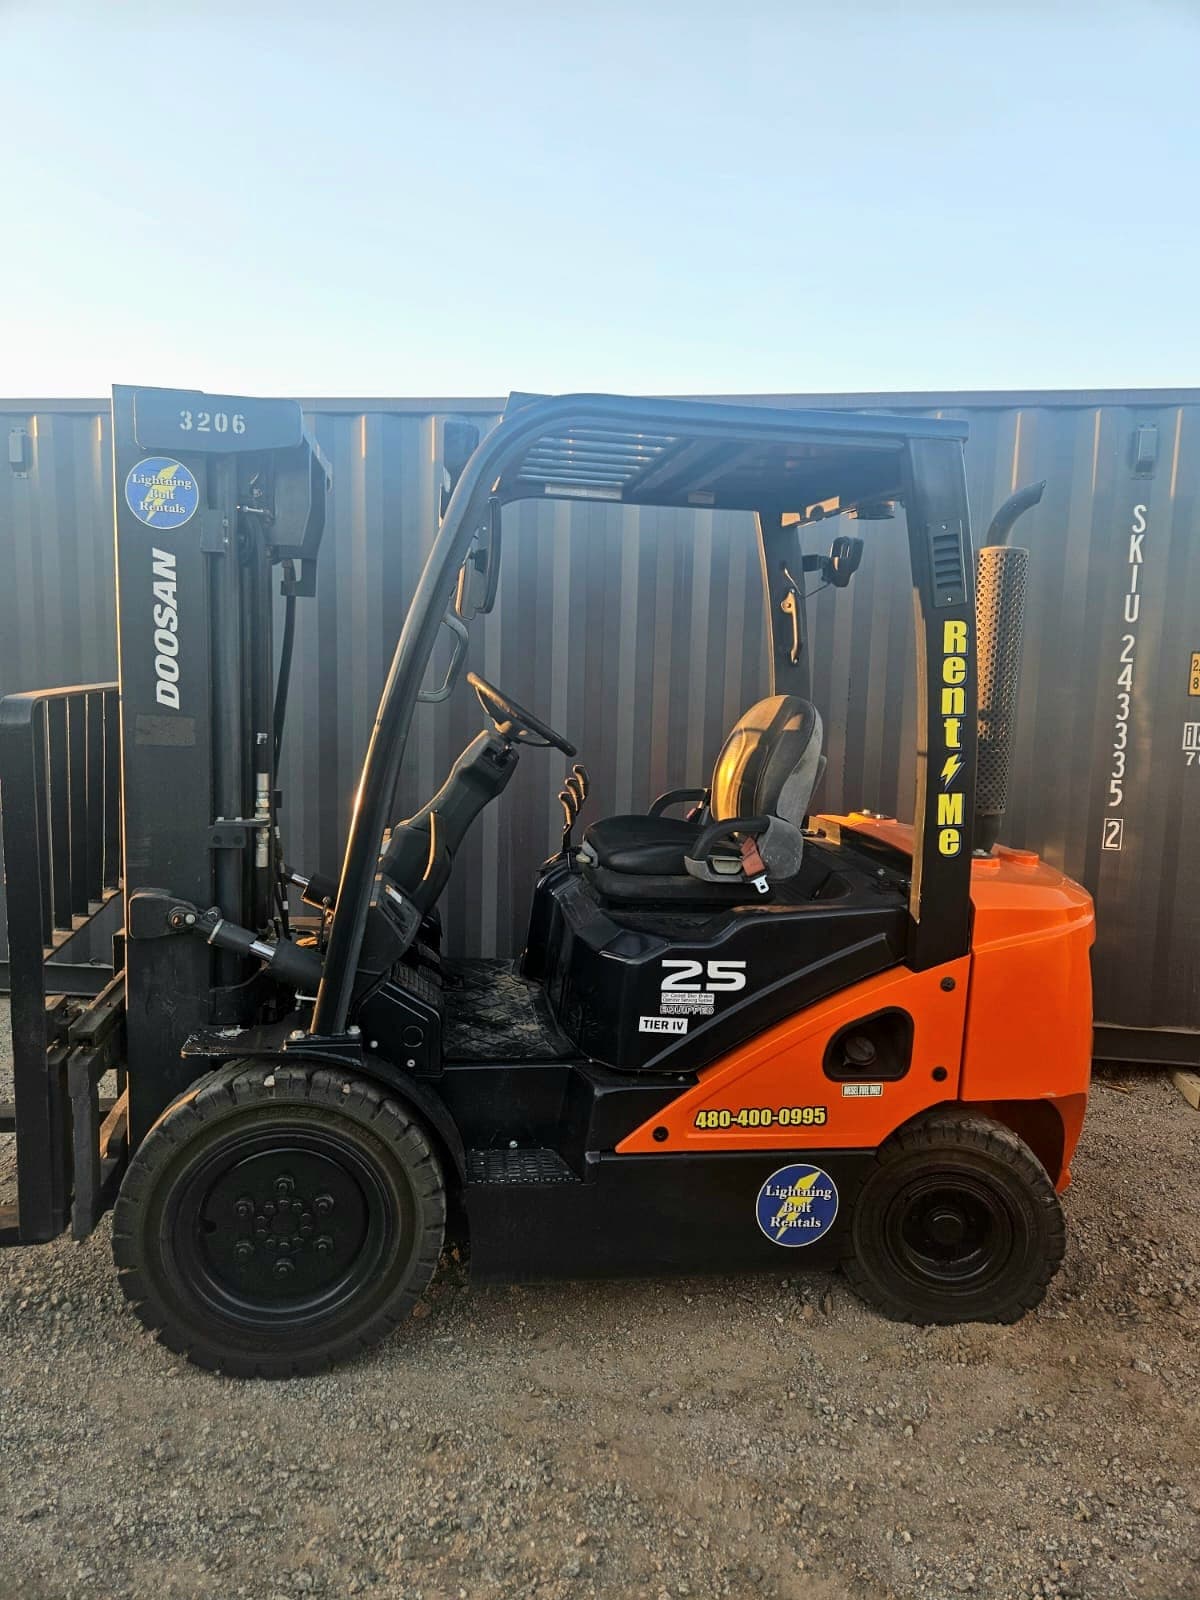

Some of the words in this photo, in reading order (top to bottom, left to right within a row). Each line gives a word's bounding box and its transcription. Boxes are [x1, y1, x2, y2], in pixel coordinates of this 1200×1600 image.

[179, 410, 246, 434] 3206
[132, 473, 192, 490] Lightning
[150, 489, 175, 500] Bolt
[139, 501, 186, 514] Rentals
[1124, 504, 1147, 623] SKIU
[152, 547, 180, 710] DOOSAN
[941, 620, 968, 749] Rent
[1109, 634, 1135, 807] 243335
[937, 793, 964, 855] Me
[1105, 821, 1120, 848] 2
[661, 960, 746, 991] 25
[643, 1020, 669, 1030] TIER
[672, 1021, 684, 1030] IV
[695, 1107, 826, 1128] 480-400-0995
[765, 1185, 832, 1200] Lightning
[783, 1201, 812, 1213] Bolt
[770, 1216, 821, 1228] Rentals
